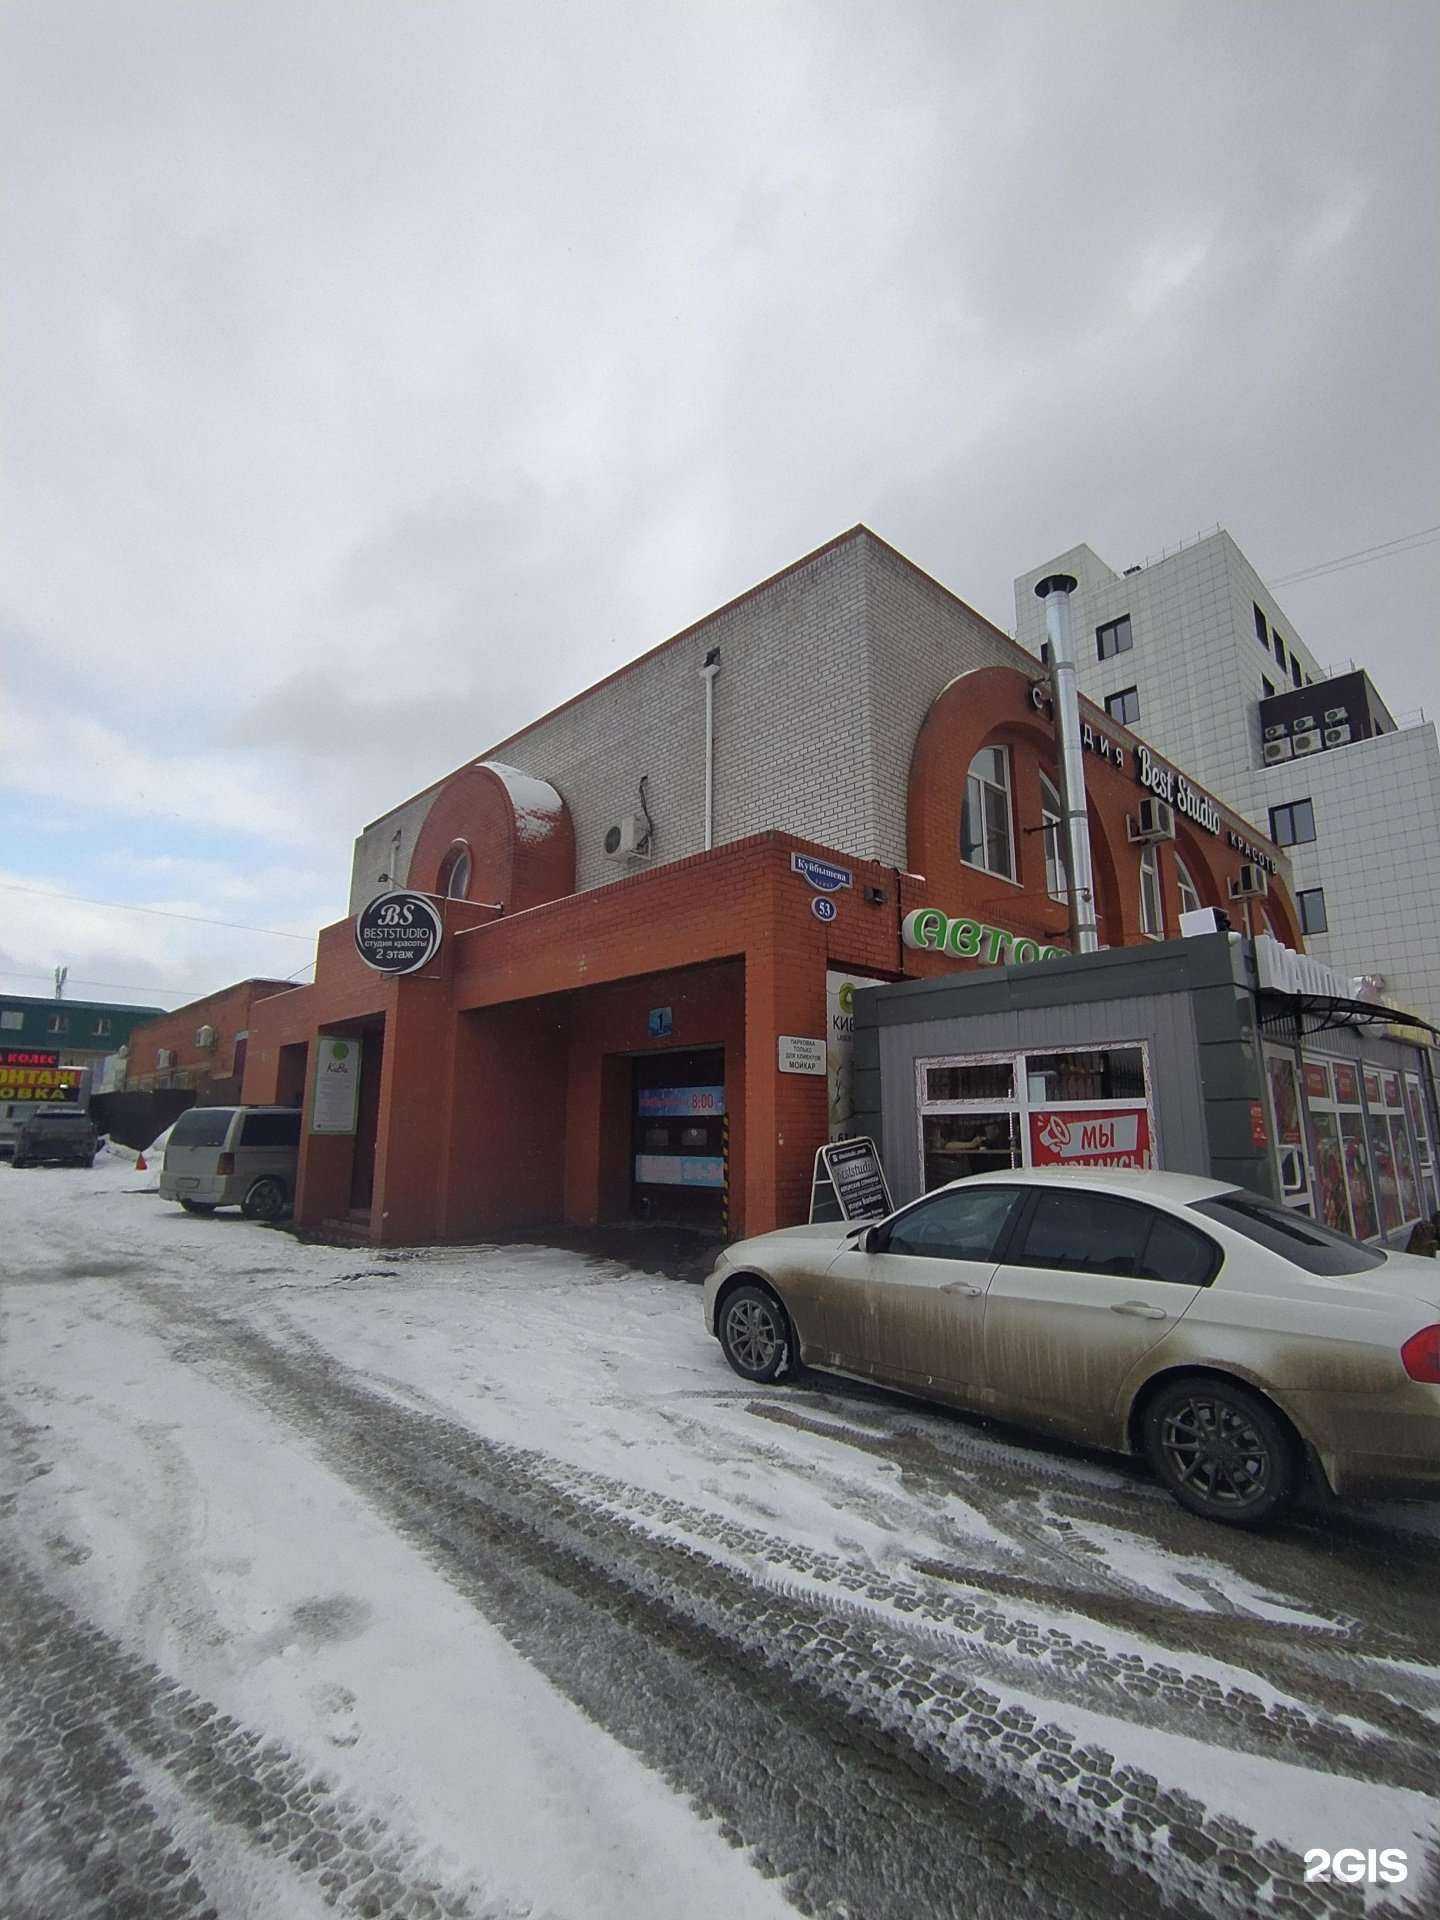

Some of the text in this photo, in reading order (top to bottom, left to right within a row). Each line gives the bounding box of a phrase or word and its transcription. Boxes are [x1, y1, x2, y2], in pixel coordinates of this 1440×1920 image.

[1032, 687, 1125, 768] СДИЯ
[1138, 745, 1175, 803] Best
[1177, 774, 1221, 836] Studio
[797, 858, 847, 882] Куйбышева
[377, 903, 415, 926] BS
[819, 902, 832, 917] 53
[363, 927, 430, 939] BESTSTUDIO
[375, 948, 414, 959] 2 этаж
[789, 1060, 816, 1071] МОЙКАР
[1081, 1122, 1115, 1151] МЫ
